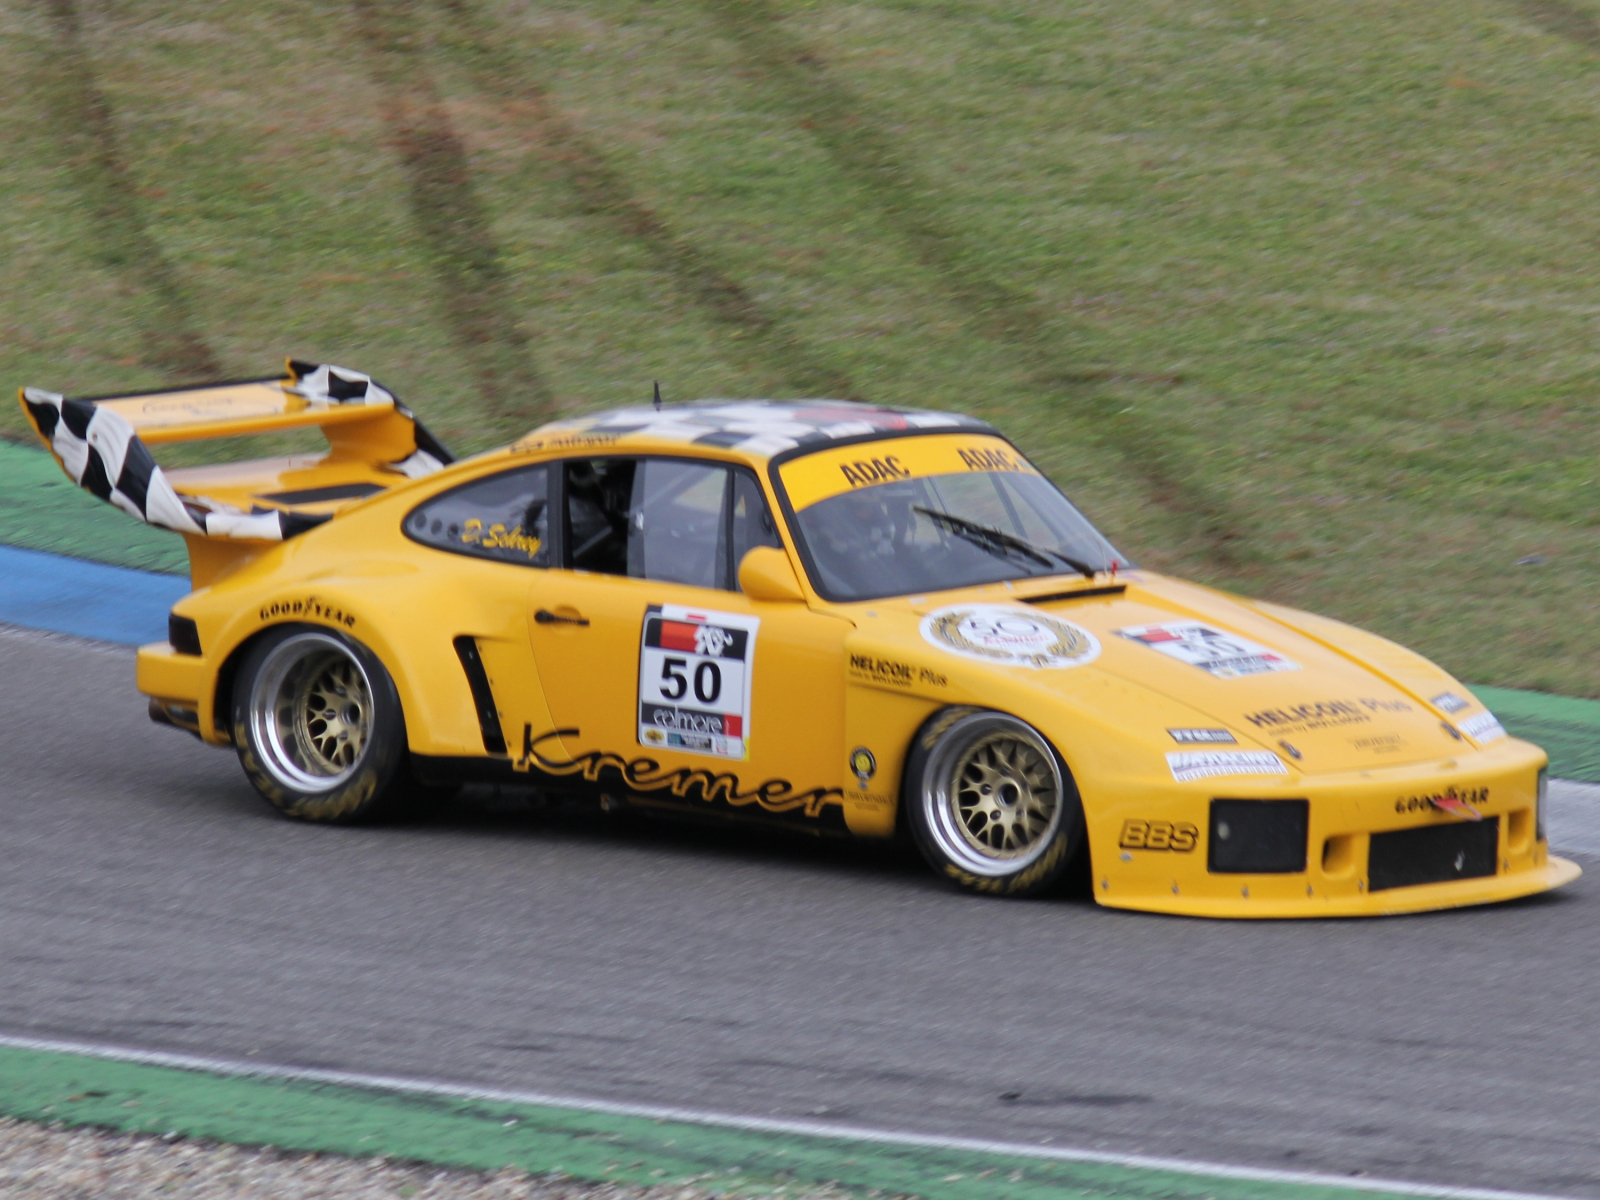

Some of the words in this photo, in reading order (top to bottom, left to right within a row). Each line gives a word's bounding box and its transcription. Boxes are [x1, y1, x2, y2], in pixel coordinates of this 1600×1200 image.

[839, 455, 911, 488] ADAC
[957, 447, 1020, 471] ADAC
[260, 595, 356, 628] GOODYEAR
[659, 655, 722, 704] 50
[850, 653, 912, 680] HELICOIL
[919, 667, 948, 687] Plus
[1243, 698, 1364, 729] HELICOIL
[512, 722, 844, 817] Kremer
[1118, 818, 1199, 852] BBS
